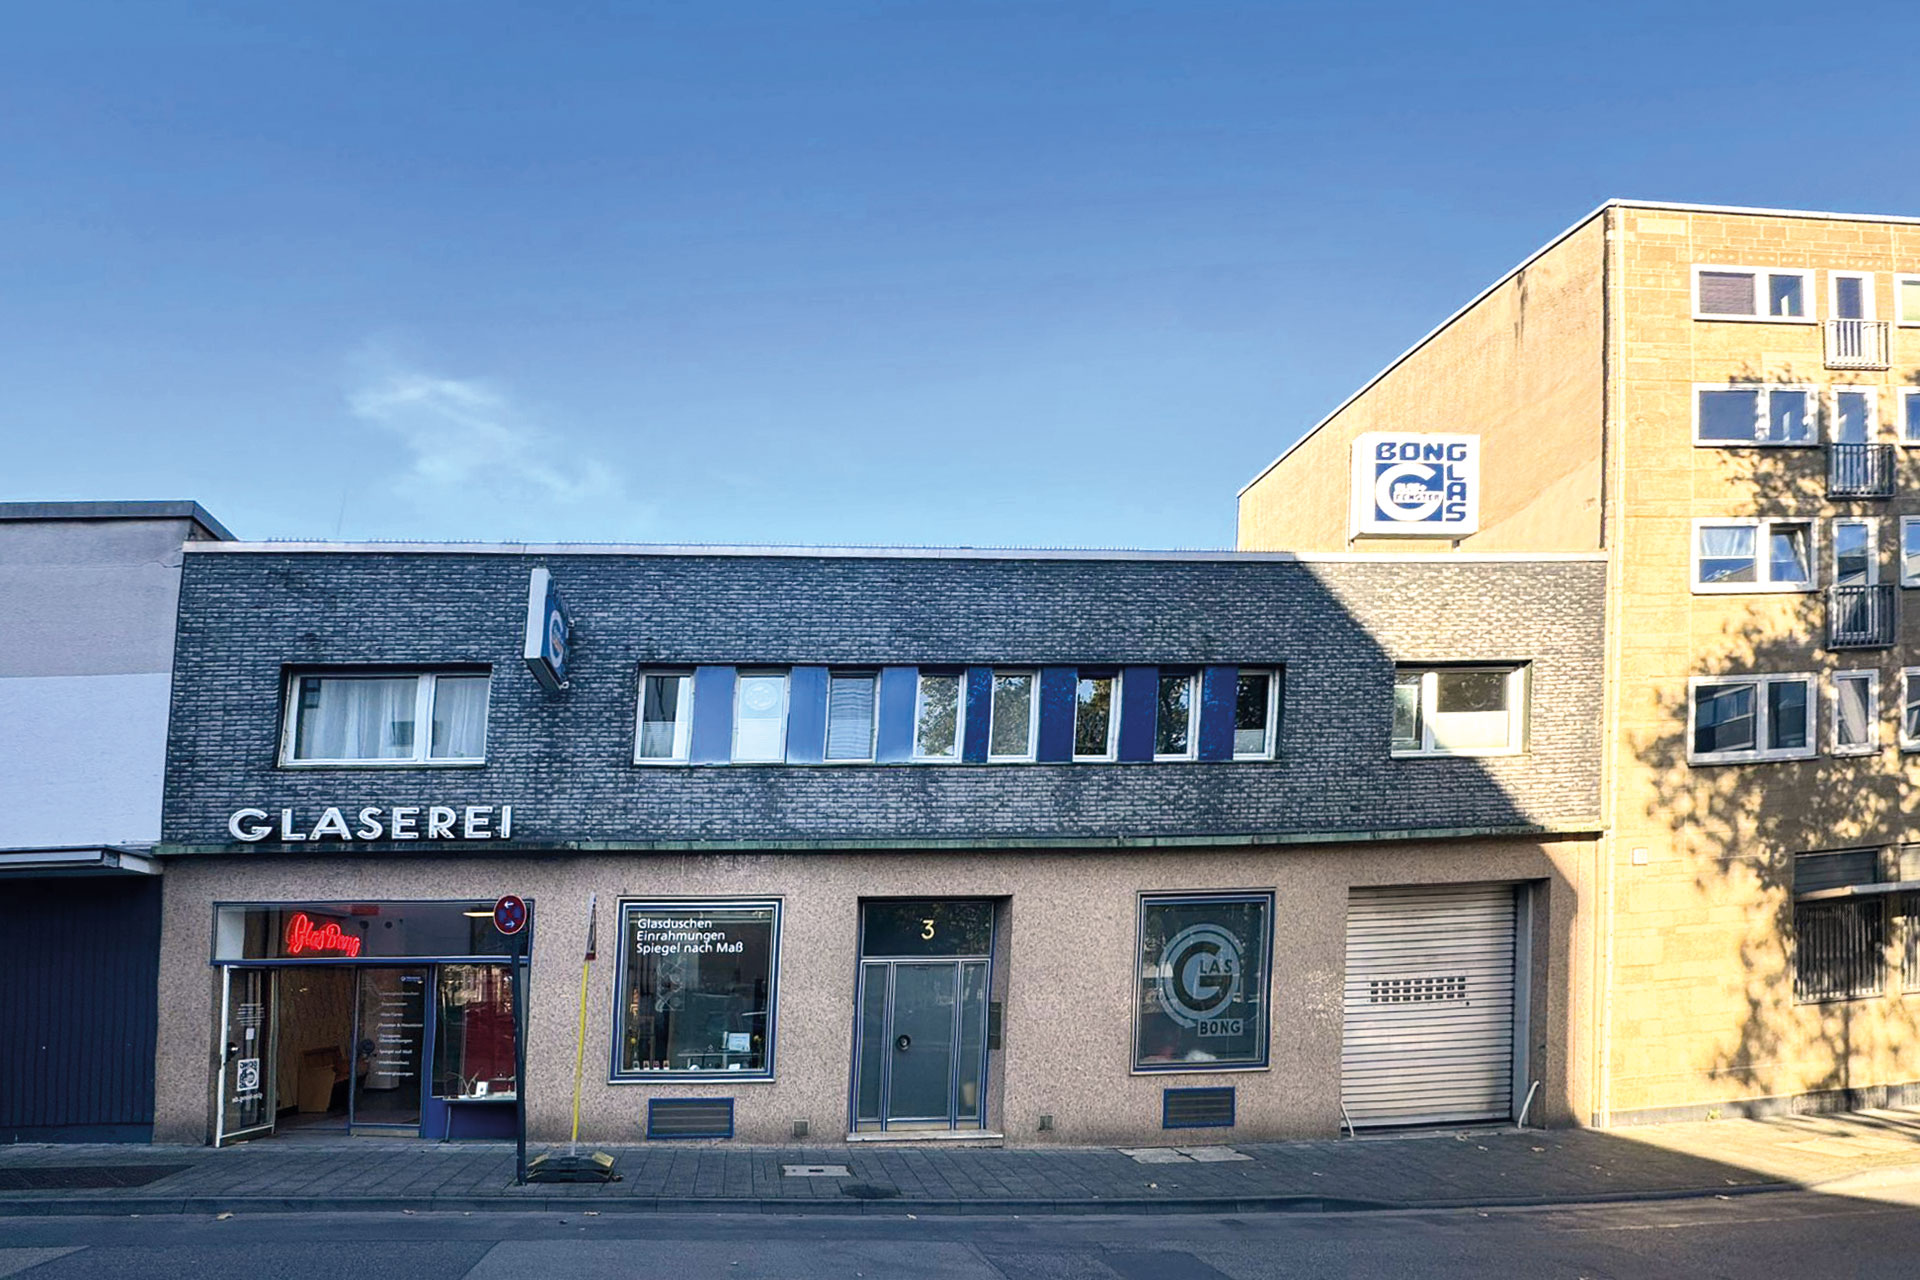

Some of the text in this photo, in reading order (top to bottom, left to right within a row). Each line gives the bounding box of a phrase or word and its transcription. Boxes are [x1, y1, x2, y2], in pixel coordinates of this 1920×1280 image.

[1376, 442, 1467, 461] BONG
[228, 806, 512, 841] GLASEREI
[637, 918, 713, 929] Glasduschen
[921, 919, 935, 940] 3
[636, 930, 726, 943] Einrahmungen
[636, 941, 744, 956] Spiegel nach Maß
[1199, 1020, 1241, 1035] BONG
